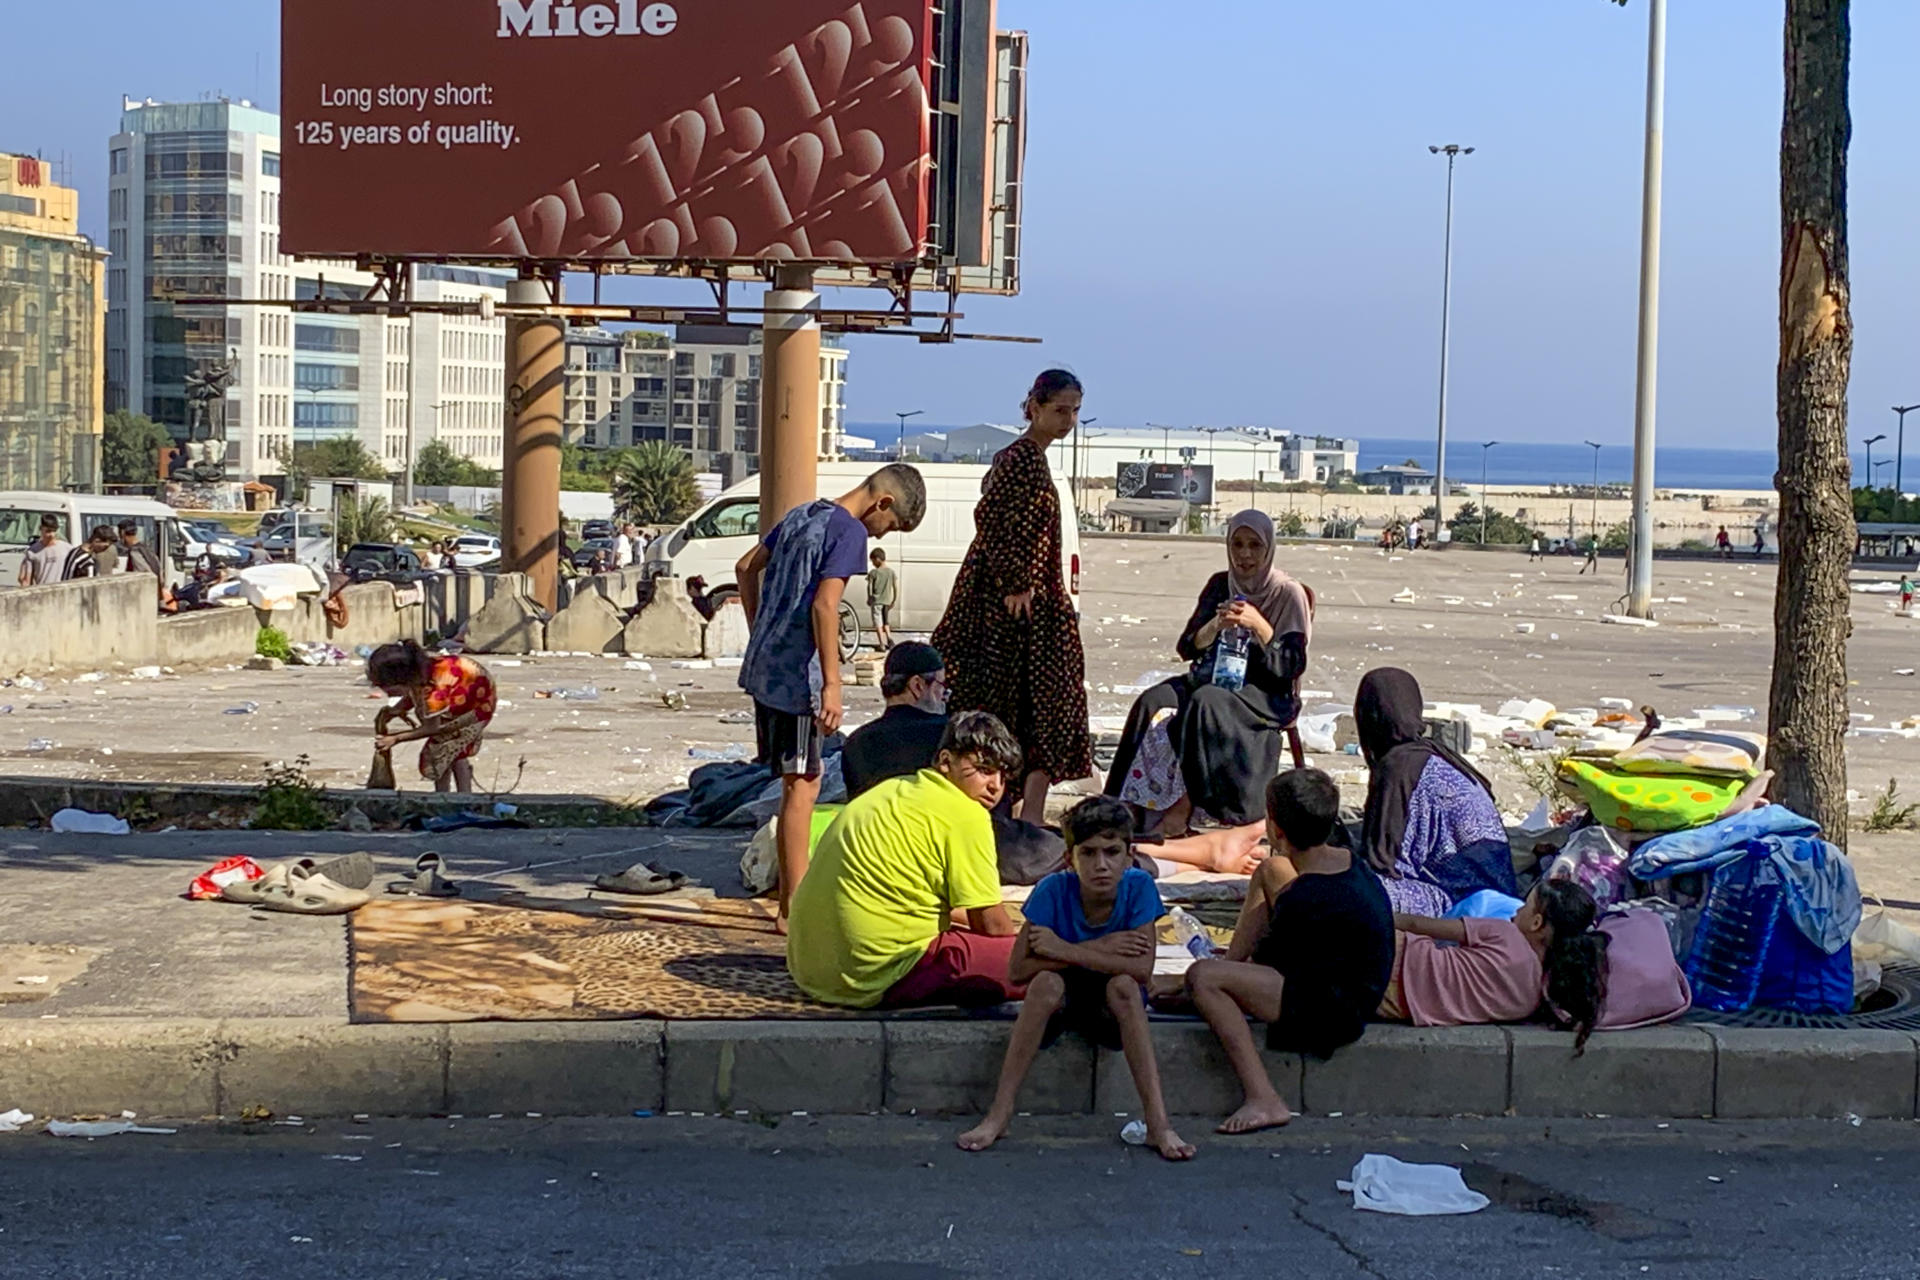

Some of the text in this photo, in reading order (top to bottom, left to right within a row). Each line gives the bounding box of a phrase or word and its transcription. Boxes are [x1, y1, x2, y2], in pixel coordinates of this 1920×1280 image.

[496, 0, 678, 38] Miele
[320, 82, 493, 112] Long story short:
[294, 120, 520, 149] 125 years of quality.
